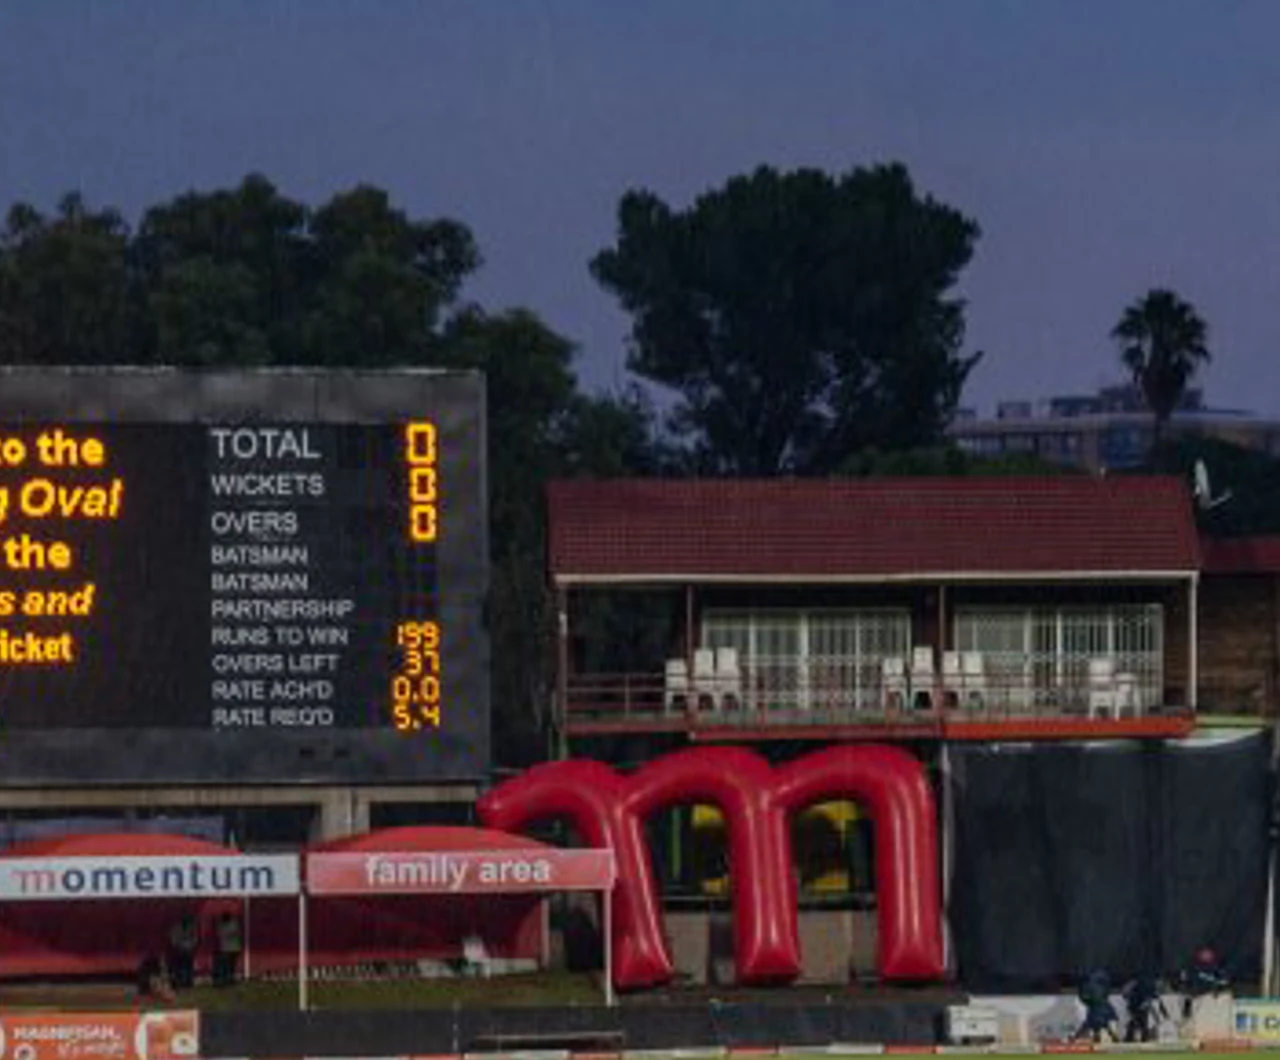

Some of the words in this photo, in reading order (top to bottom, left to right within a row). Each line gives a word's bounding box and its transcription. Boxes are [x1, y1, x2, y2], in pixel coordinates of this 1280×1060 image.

[36, 428, 105, 465] the
[210, 428, 322, 459] TOTAL
[406, 422, 437, 465] 0
[20, 477, 125, 518] Oval
[210, 473, 326, 496] WICKETS
[409, 466, 437, 502] 0
[210, 511, 299, 535] OVERS
[410, 503, 438, 542] 0
[3, 532, 72, 570] the
[210, 546, 309, 565] BATSMAN
[210, 573, 309, 591] BATSMAN
[21, 582, 96, 617] and
[210, 599, 356, 619] PARTNERSHIP
[210, 627, 270, 646] RUNS
[275, 628, 305, 645] TO
[307, 627, 350, 645] WIN
[210, 654, 284, 673] OVERS
[287, 654, 341, 673] LEFT
[210, 680, 266, 700] RATE
[269, 680, 334, 700] ACH'D
[210, 706, 266, 726] RATE
[18, 860, 276, 895] momentum
[365, 855, 468, 889] family
[479, 858, 552, 885] area
